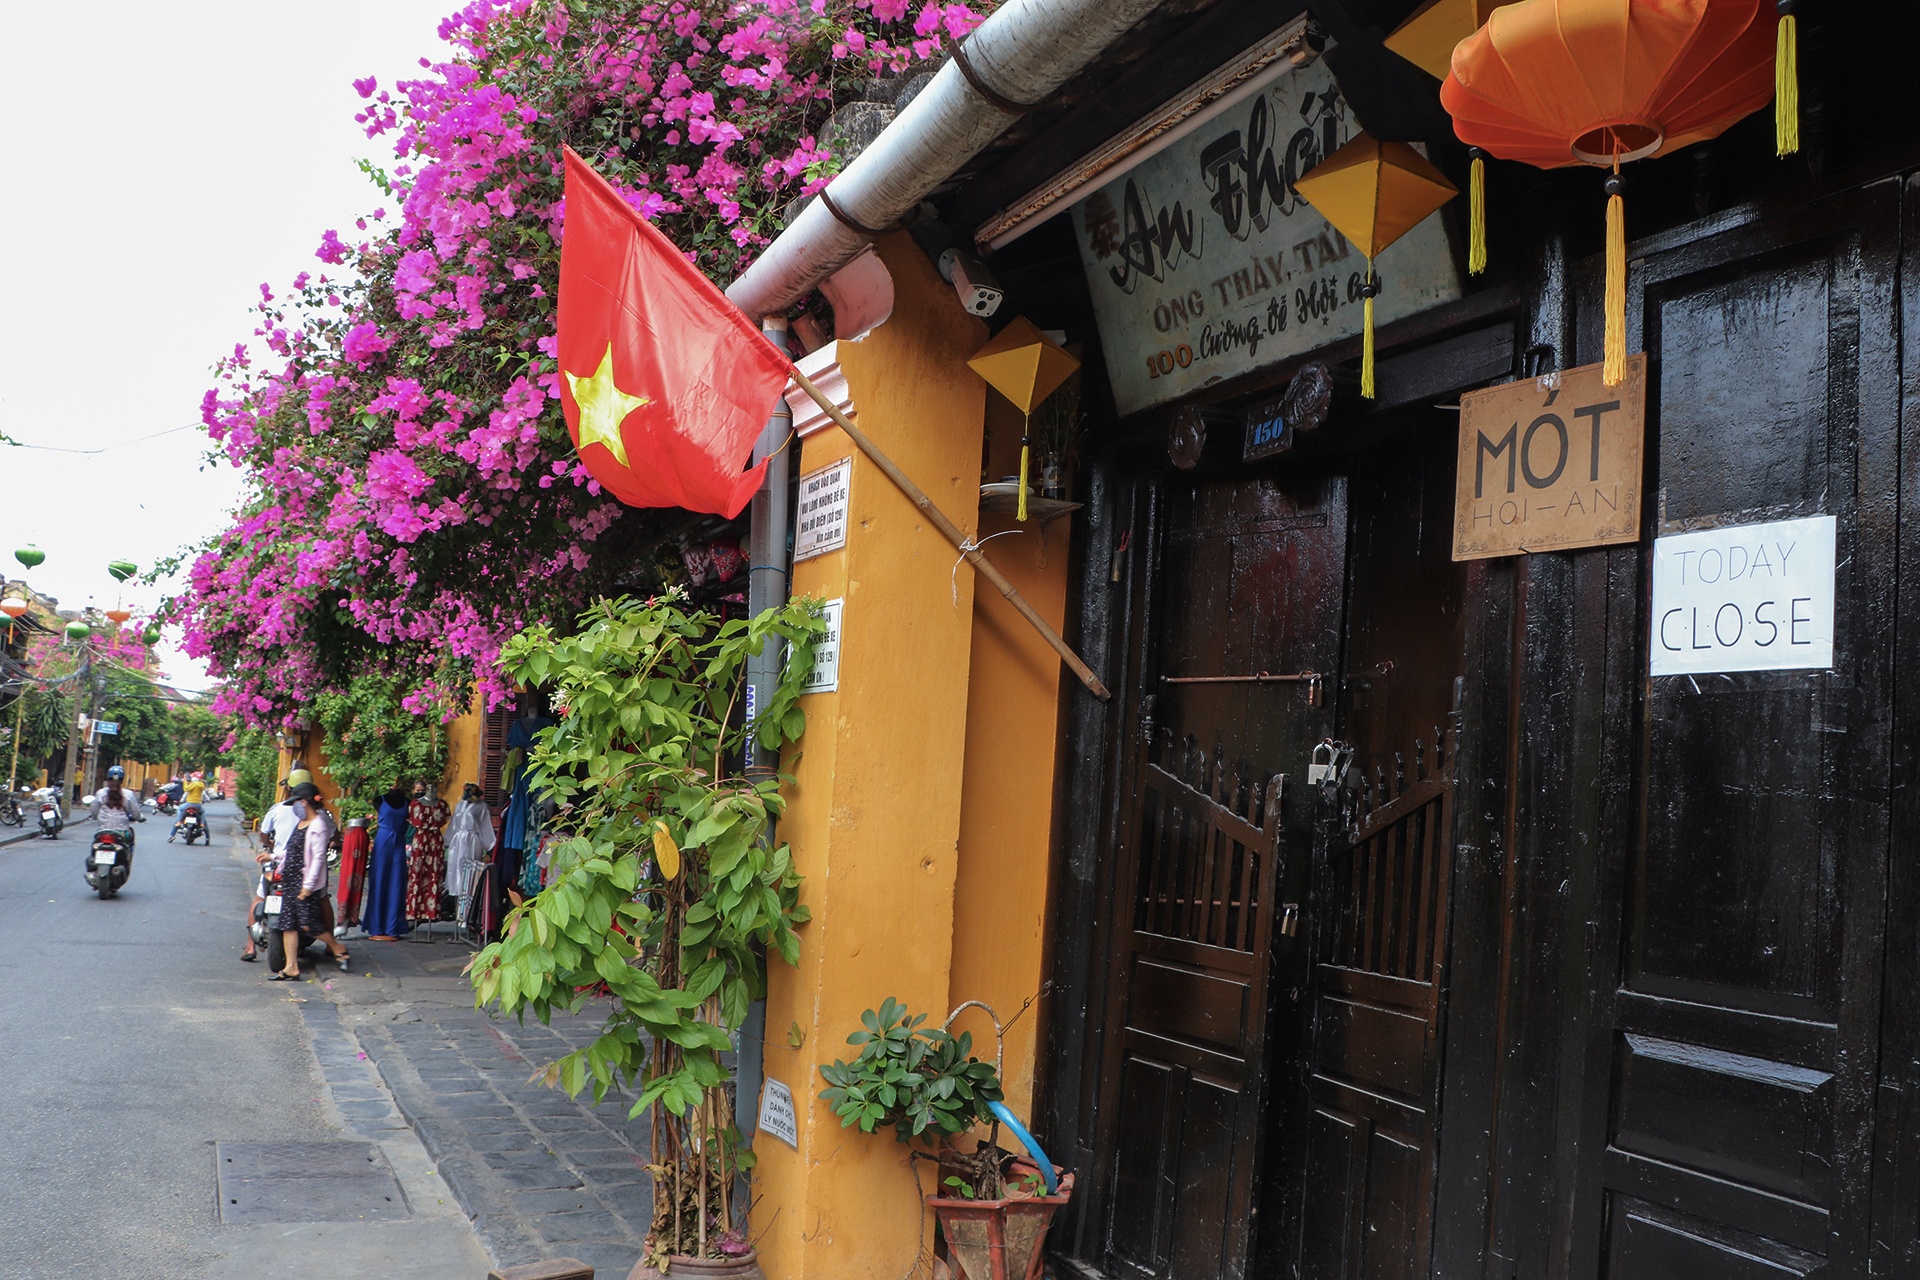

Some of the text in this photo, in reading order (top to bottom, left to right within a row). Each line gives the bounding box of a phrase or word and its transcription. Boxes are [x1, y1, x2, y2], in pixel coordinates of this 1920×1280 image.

[1153, 289, 1204, 333] ÔNG
[1253, 416, 1283, 446] 150
[1475, 389, 1621, 499] MÓT
[1673, 541, 1797, 586] TODAY
